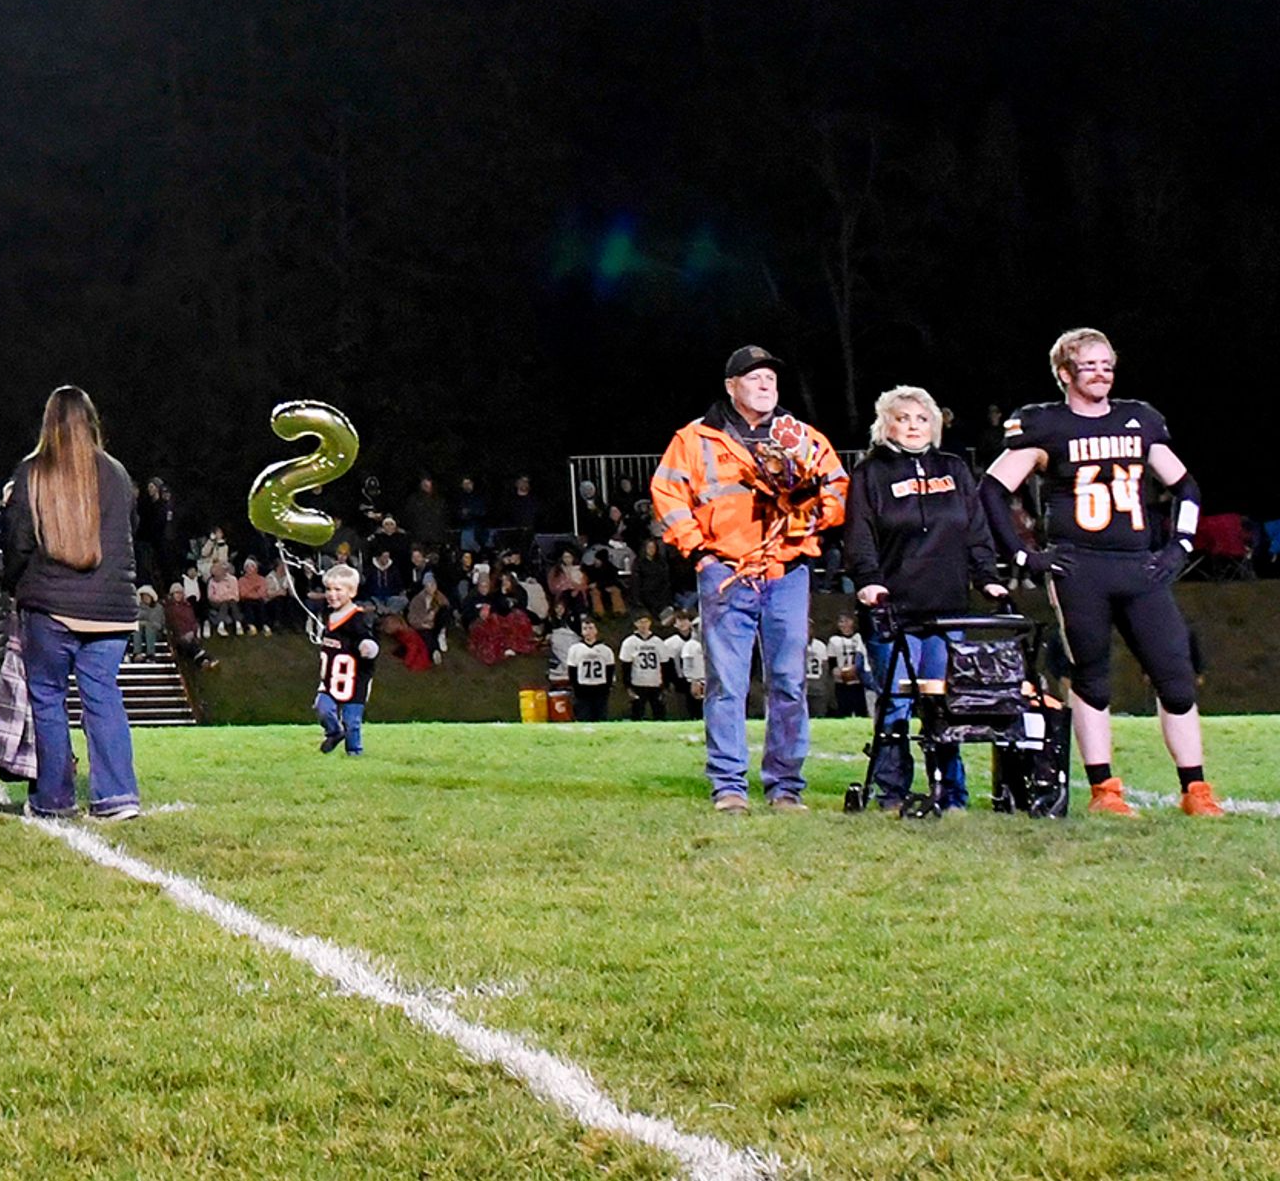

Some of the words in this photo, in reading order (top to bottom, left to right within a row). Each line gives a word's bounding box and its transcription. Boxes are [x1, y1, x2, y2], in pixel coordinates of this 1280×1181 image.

[248, 399, 360, 546] 2
[1074, 463, 1145, 532] 64
[582, 661, 602, 678] 72
[639, 652, 657, 670] 39
